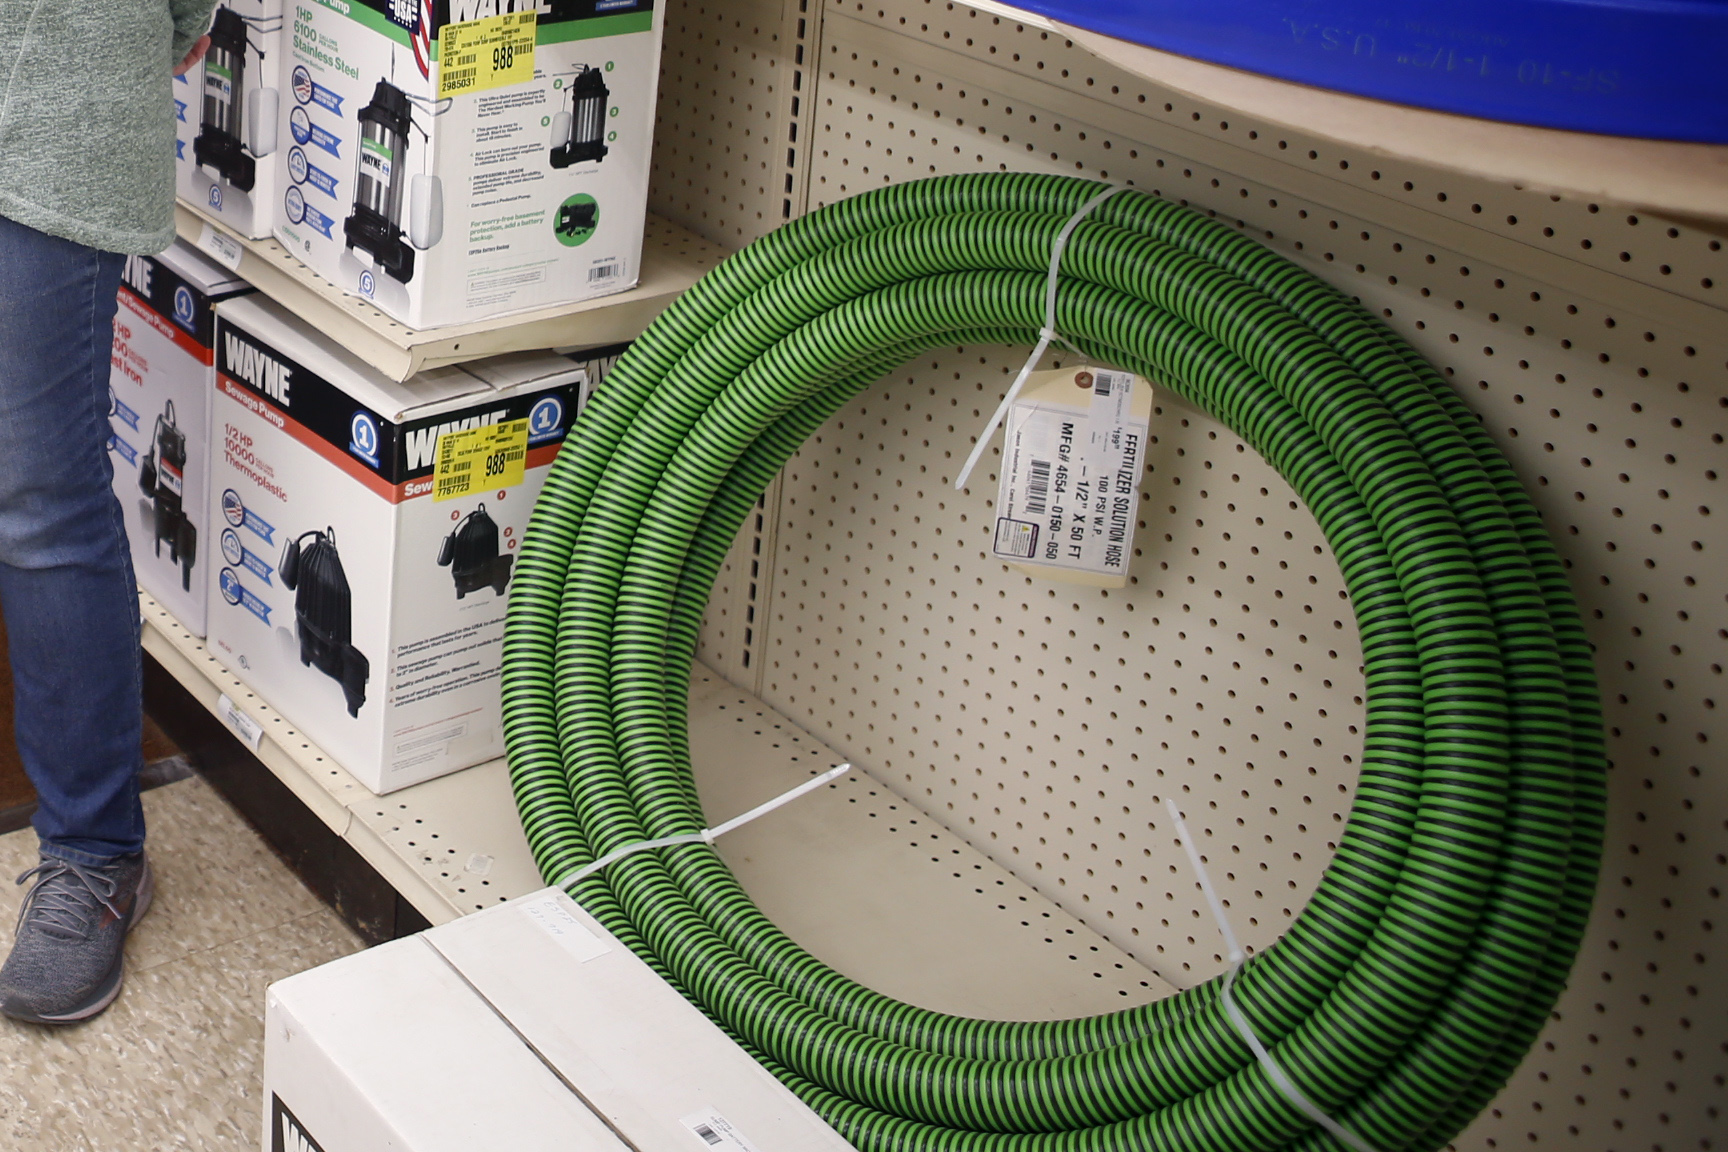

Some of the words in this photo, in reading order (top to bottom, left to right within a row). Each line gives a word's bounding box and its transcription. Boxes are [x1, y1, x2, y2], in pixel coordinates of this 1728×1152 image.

[294, 20, 317, 42] 6100
[293, 35, 334, 67] Stainless
[335, 56, 359, 81] Steel
[492, 45, 514, 72] 988
[442, 77, 476, 93] 2985031
[515, 209, 546, 220] basement
[521, 218, 544, 228] battery
[124, 359, 143, 387] Iron
[224, 331, 291, 407] WAYNE
[225, 380, 259, 410] Sewage
[259, 402, 285, 428] Pump
[224, 421, 239, 441] 1/2
[239, 431, 253, 448] HP
[1058, 422, 1074, 463] MFG#
[224, 436, 256, 465] 10000
[224, 450, 288, 503] Thermoplastic
[485, 452, 506, 477] 988
[404, 481, 433, 497] Sew
[437, 482, 470, 497] 7767723
[1097, 475, 1109, 493] 100
[1096, 496, 1106, 513] PSI
[1108, 496, 1130, 542] SOLUTION
[1071, 526, 1084, 541] 50
[1068, 544, 1082, 559] FT
[1105, 540, 1122, 567] HOSE
